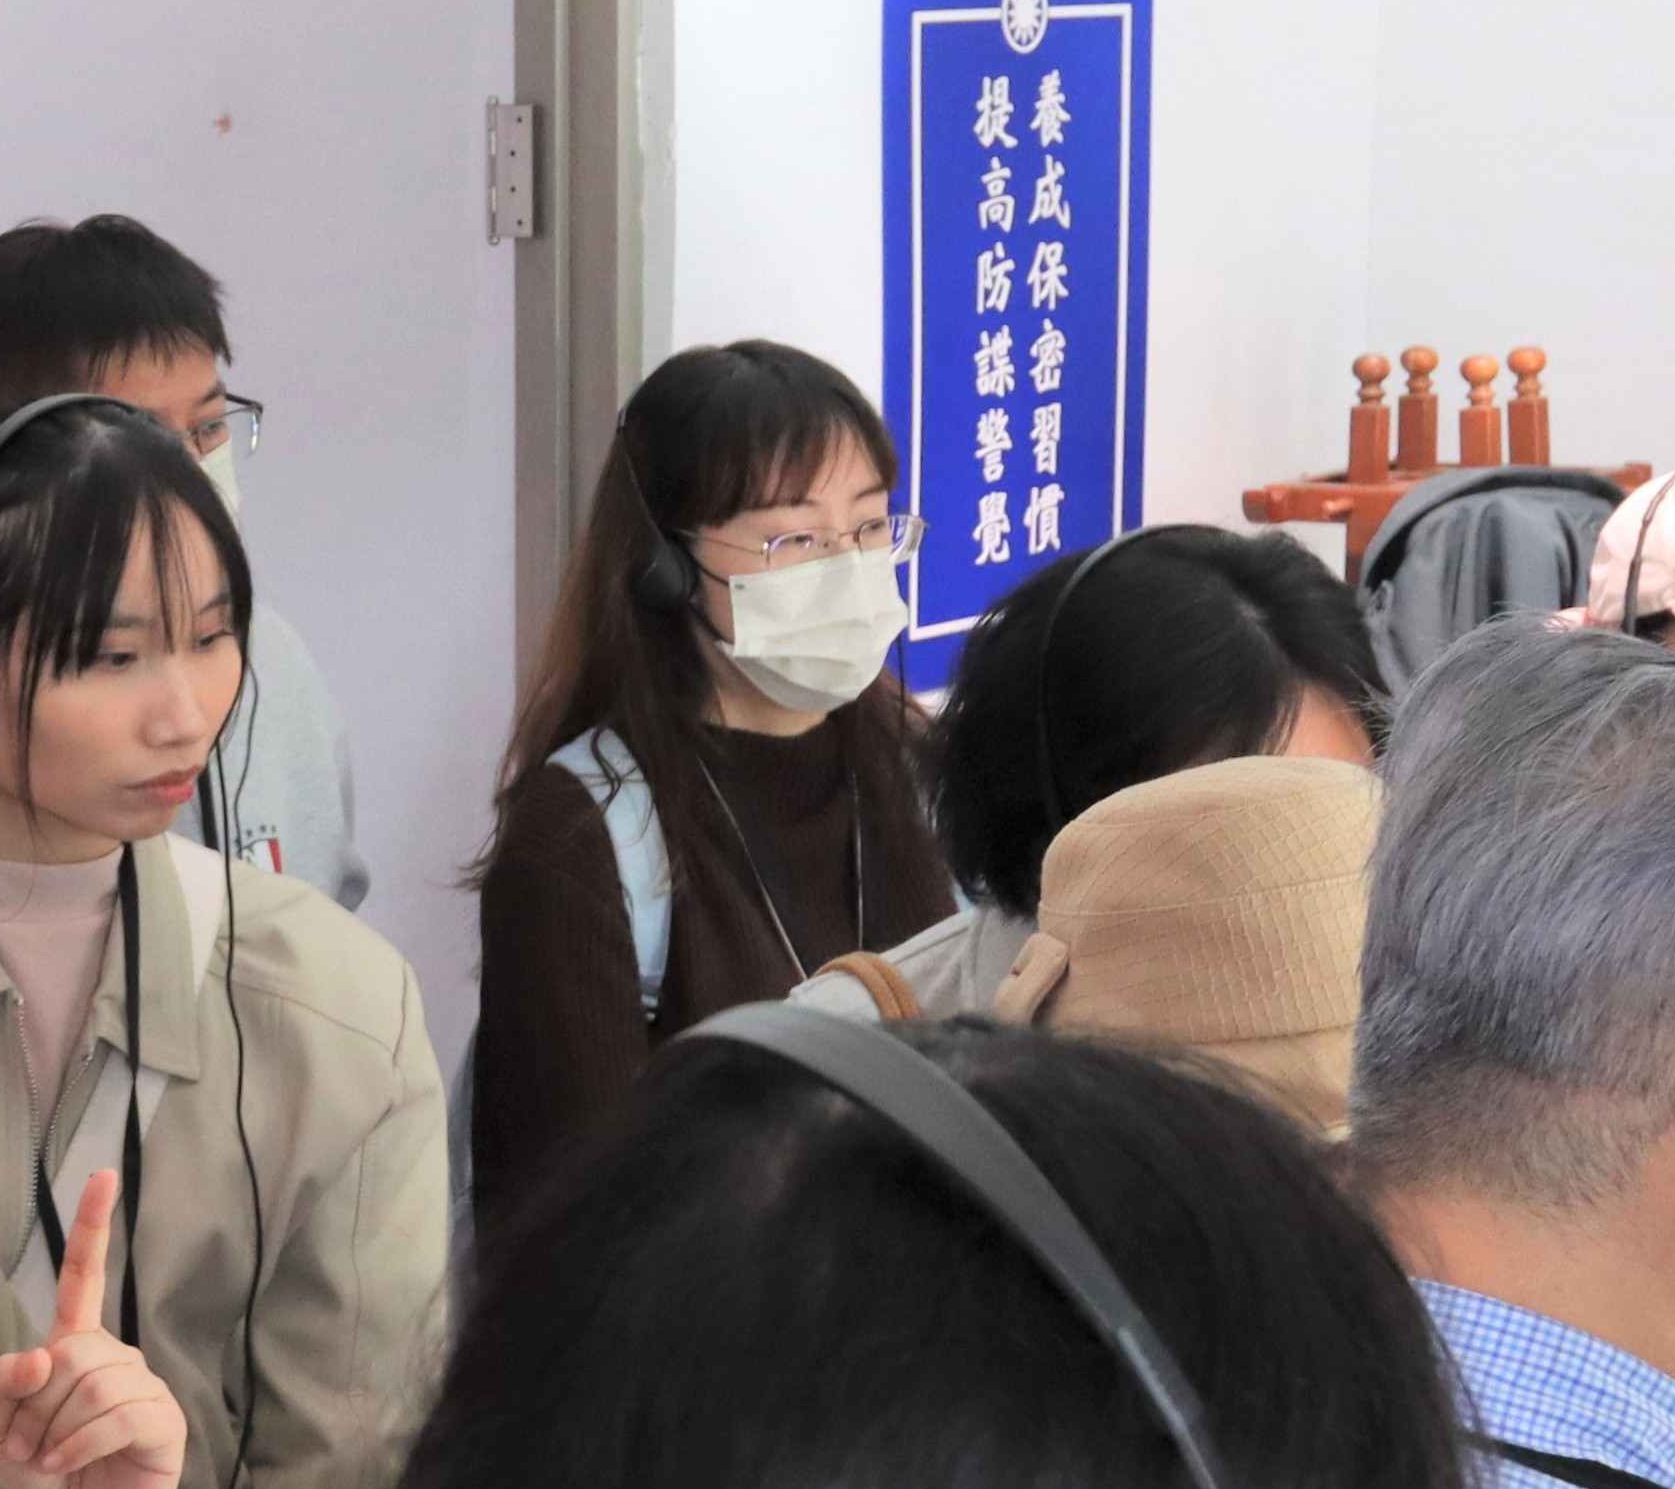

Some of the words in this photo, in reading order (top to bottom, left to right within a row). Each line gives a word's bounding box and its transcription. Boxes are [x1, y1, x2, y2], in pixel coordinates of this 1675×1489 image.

[973, 75, 1018, 566] 提高防諜警覺
[1024, 69, 1071, 555] 養成保密習慣
